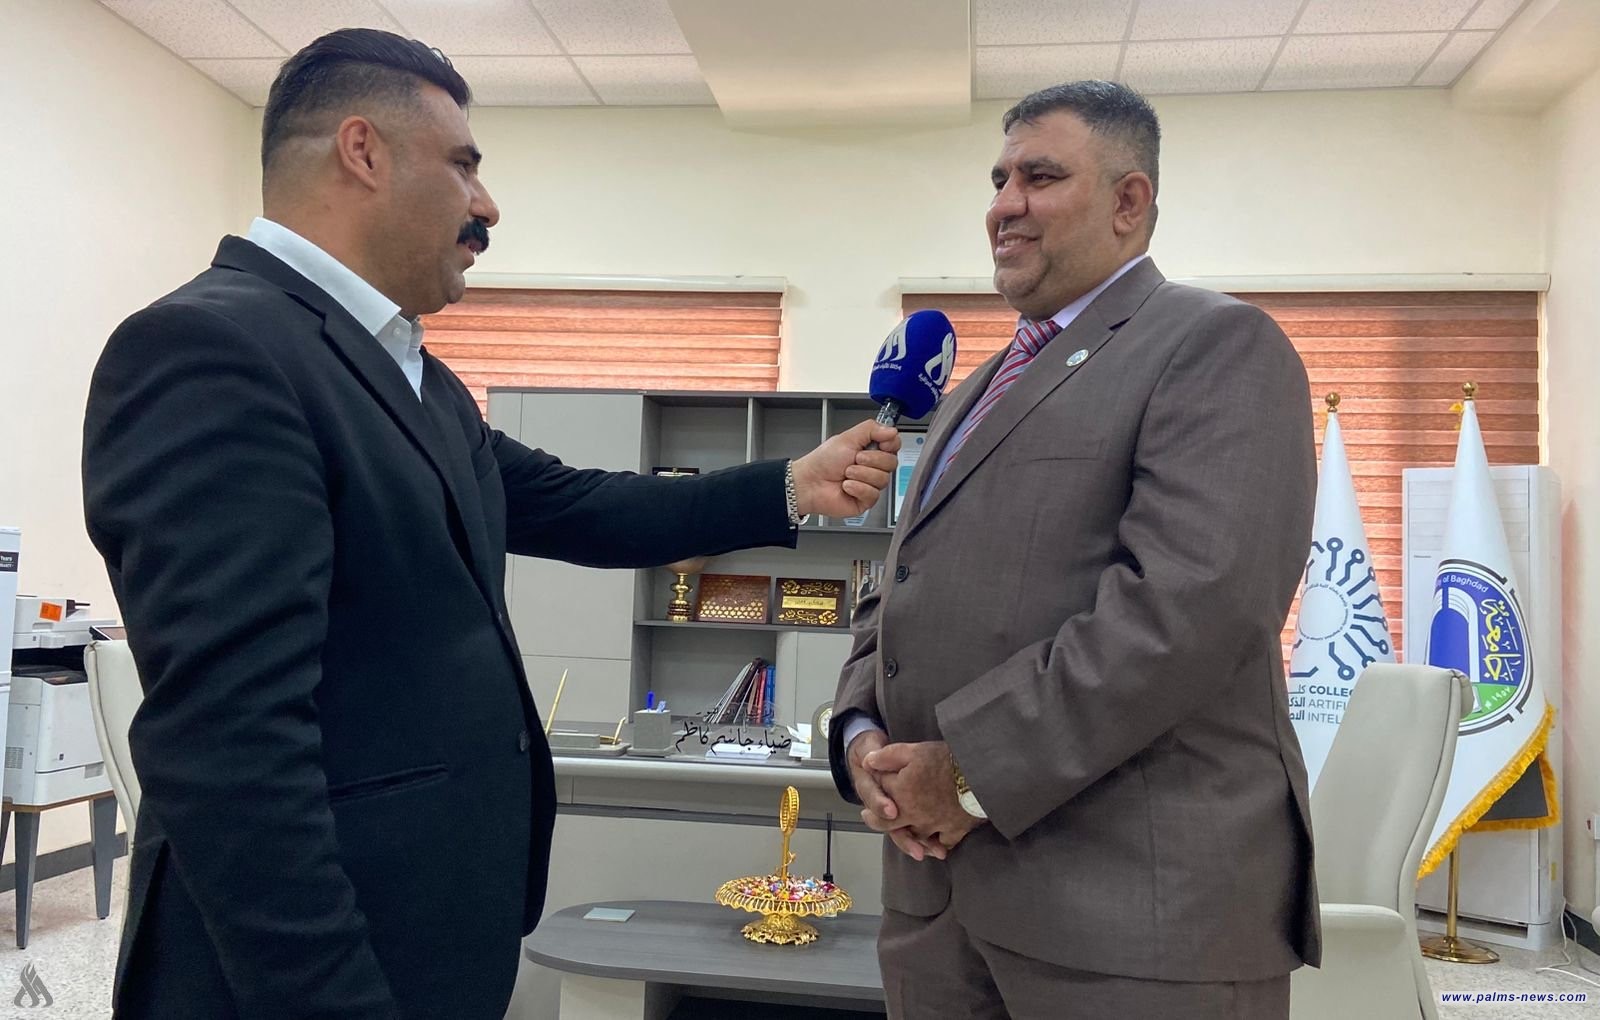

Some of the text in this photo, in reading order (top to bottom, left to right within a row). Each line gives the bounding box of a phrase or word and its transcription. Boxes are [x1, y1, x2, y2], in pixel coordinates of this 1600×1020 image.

[1442, 575, 1449, 583] of
[1450, 575, 1489, 593] Baghdad
[1288, 684, 1307, 695] كل
[1288, 696, 1306, 708] الذك
[1308, 699, 1347, 711] ARTIFI
[1307, 711, 1342, 725] INTEL
[675, 720, 792, 755] ضياء جاسم كاظم
